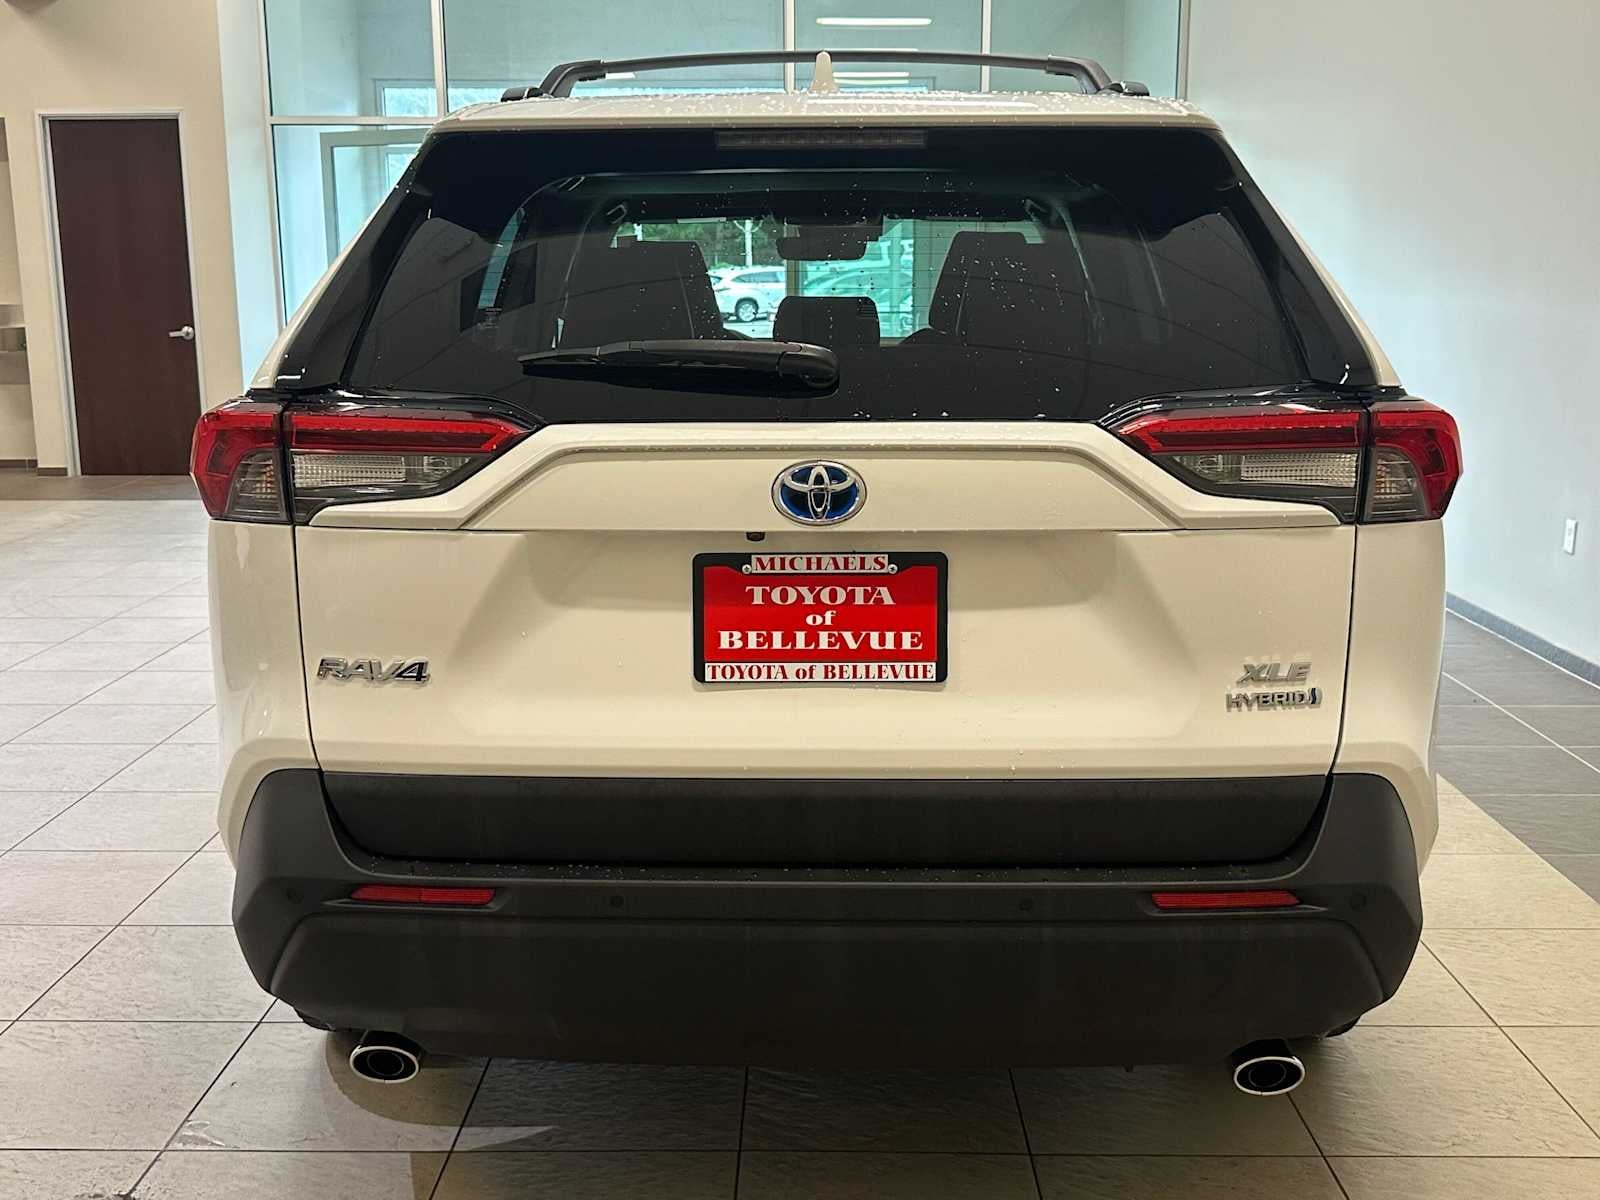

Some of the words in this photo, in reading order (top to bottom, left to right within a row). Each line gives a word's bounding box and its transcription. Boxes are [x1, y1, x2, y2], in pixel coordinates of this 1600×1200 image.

[755, 556, 887, 571] MICHAELS
[745, 586, 896, 605] TOYOTA
[805, 610, 836, 626] of
[718, 631, 923, 650] BELLEVUE
[317, 658, 430, 682] RAV4
[707, 664, 789, 680] TOYOTA
[795, 664, 817, 680] of
[823, 664, 934, 680] BELLEVUE
[1236, 661, 1312, 684] XLE
[1226, 690, 1308, 712] HYBRID
